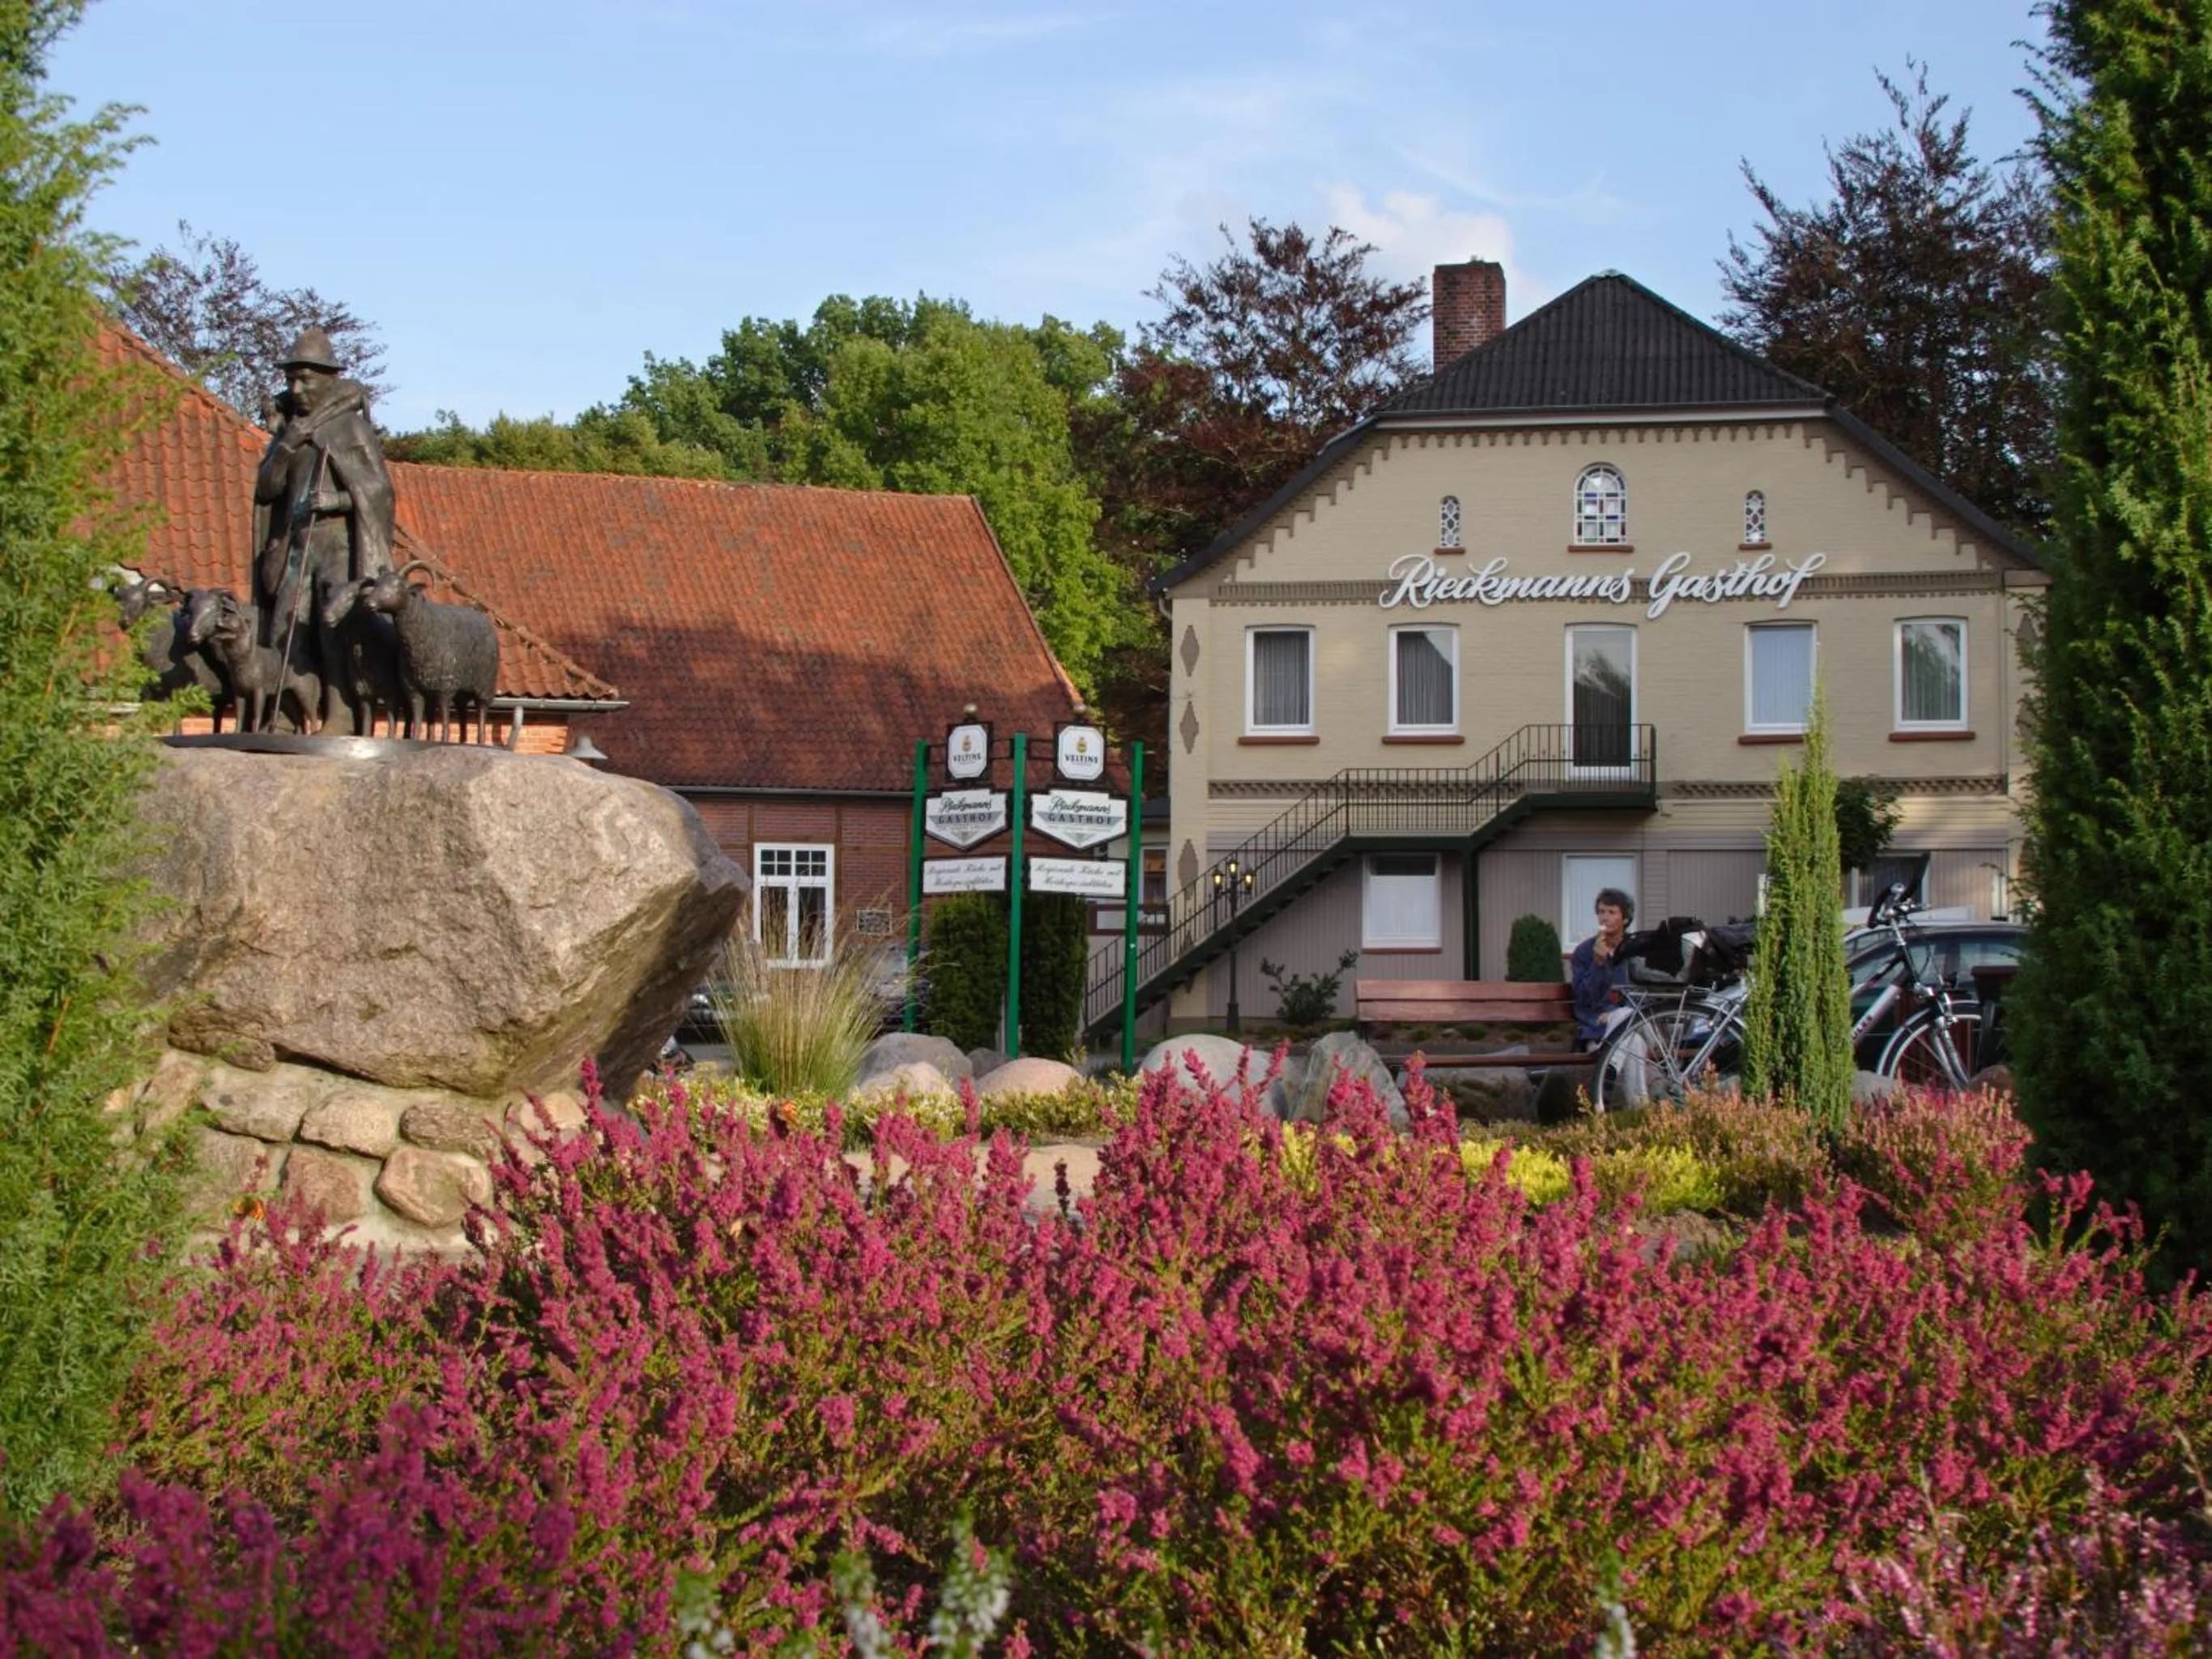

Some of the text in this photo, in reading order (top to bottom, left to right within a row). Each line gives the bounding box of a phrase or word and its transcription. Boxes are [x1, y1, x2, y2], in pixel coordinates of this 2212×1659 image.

[1379, 552, 1826, 619] Rieckmanns Gasthof
[953, 753, 982, 763] VELTINS
[1064, 753, 1098, 765] VELTINS
[939, 812, 992, 824] GASTHOF
[1048, 813, 1113, 825] GASTHOF
